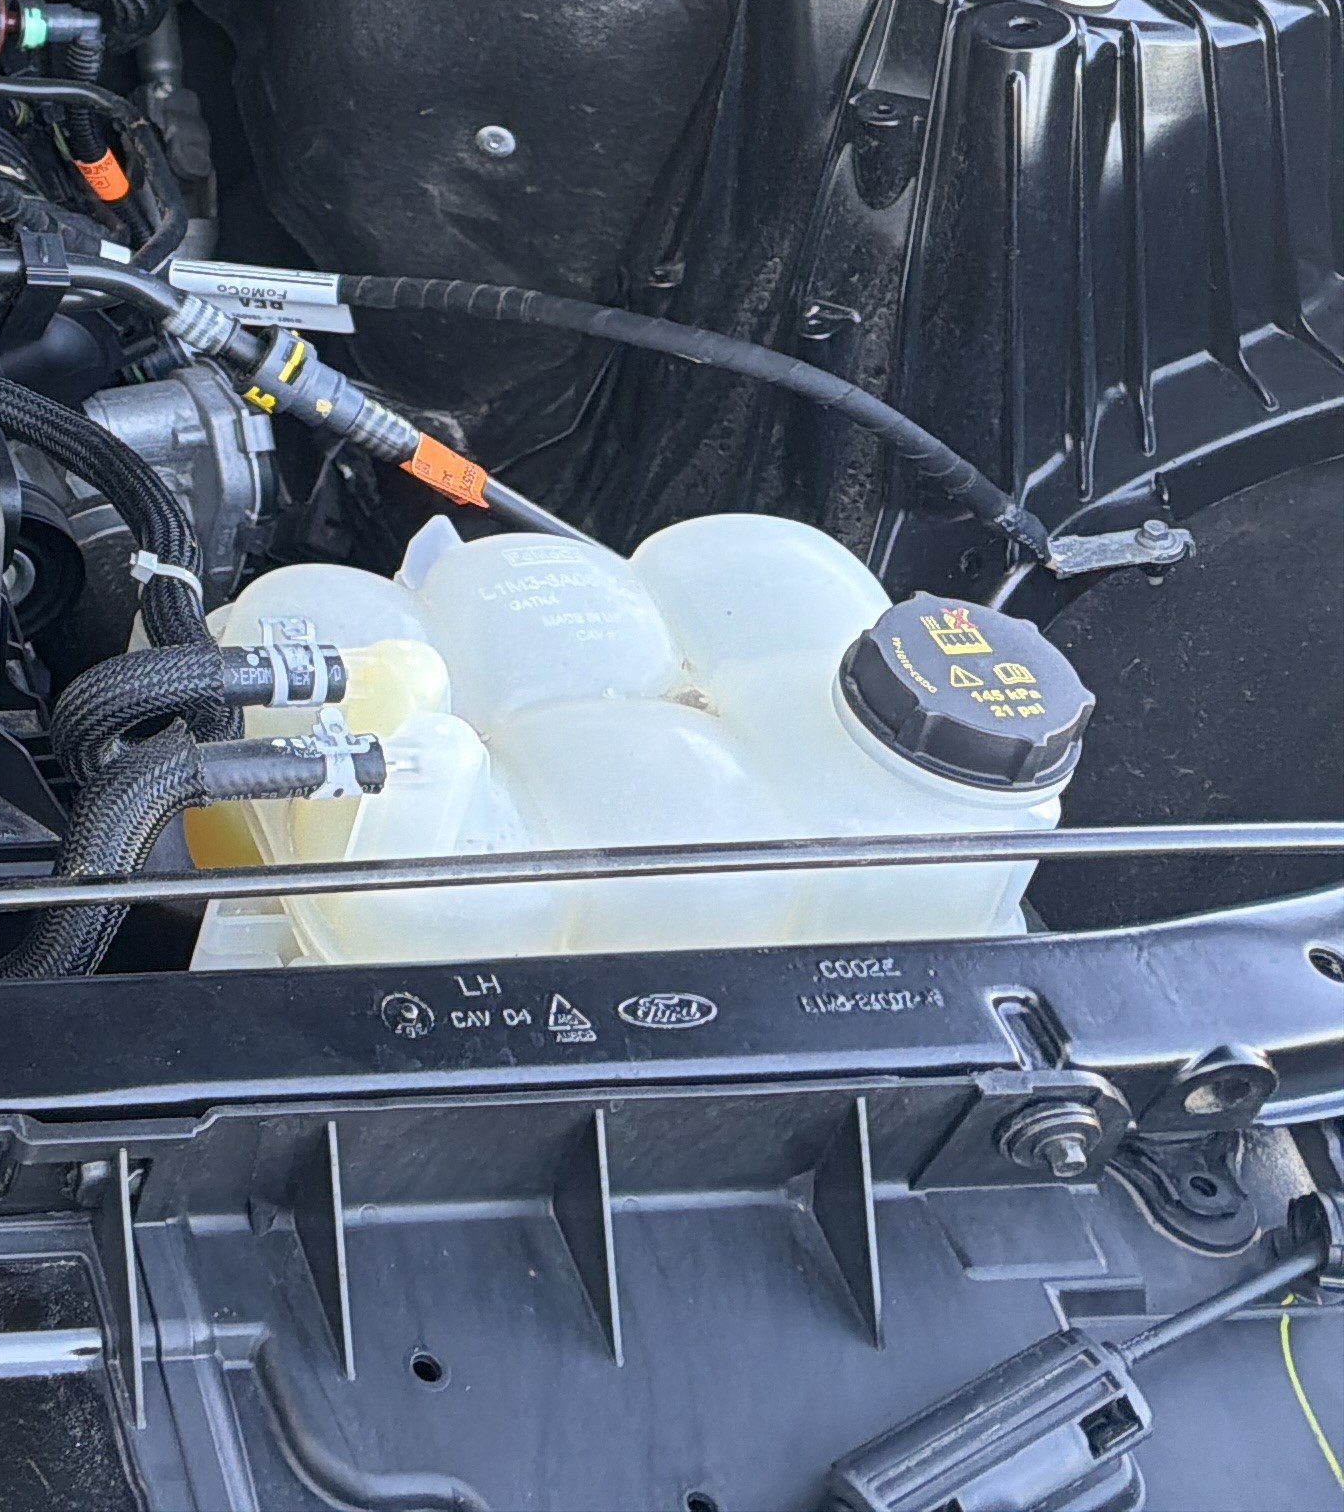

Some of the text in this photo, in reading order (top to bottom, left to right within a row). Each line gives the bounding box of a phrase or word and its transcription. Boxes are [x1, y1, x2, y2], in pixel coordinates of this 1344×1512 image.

[216, 284, 288, 300] FoMoCo
[971, 689, 1042, 703] 145 kPa
[990, 705, 1045, 719] 21 psi
[455, 973, 502, 997] LH
[450, 1007, 532, 1028] CAV 04
